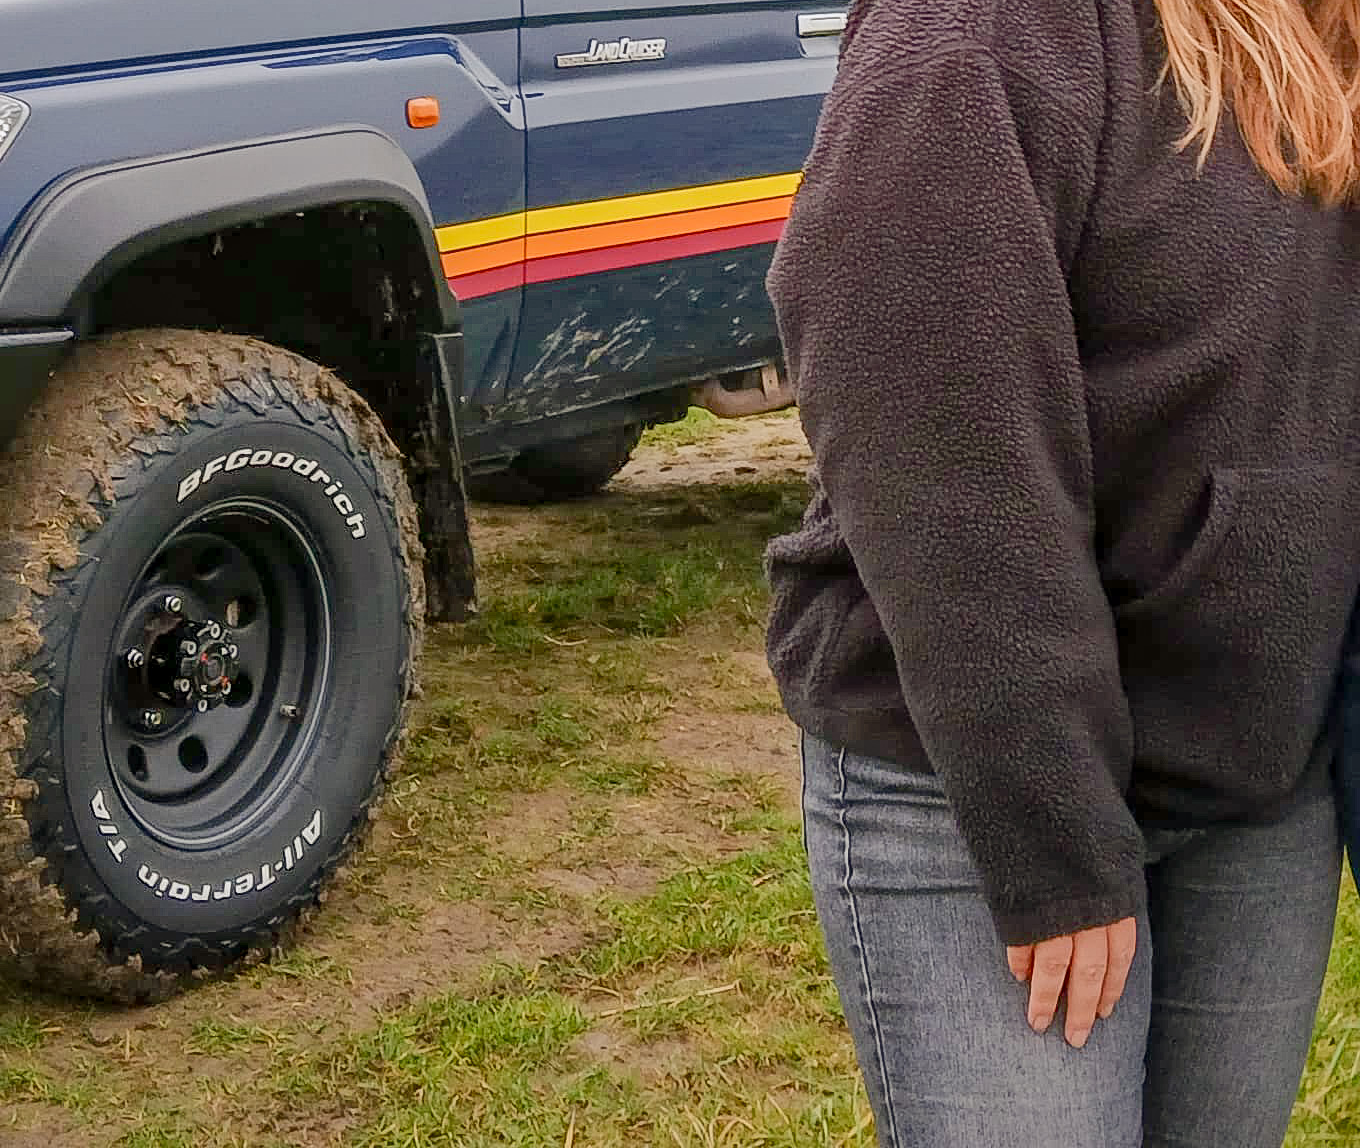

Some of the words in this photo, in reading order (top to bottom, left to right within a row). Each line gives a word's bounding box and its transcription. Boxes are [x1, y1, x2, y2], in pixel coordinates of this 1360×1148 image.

[177, 448, 367, 539] BFGoodrich
[91, 788, 128, 864] T/A
[137, 809, 322, 902] All-Terrain
